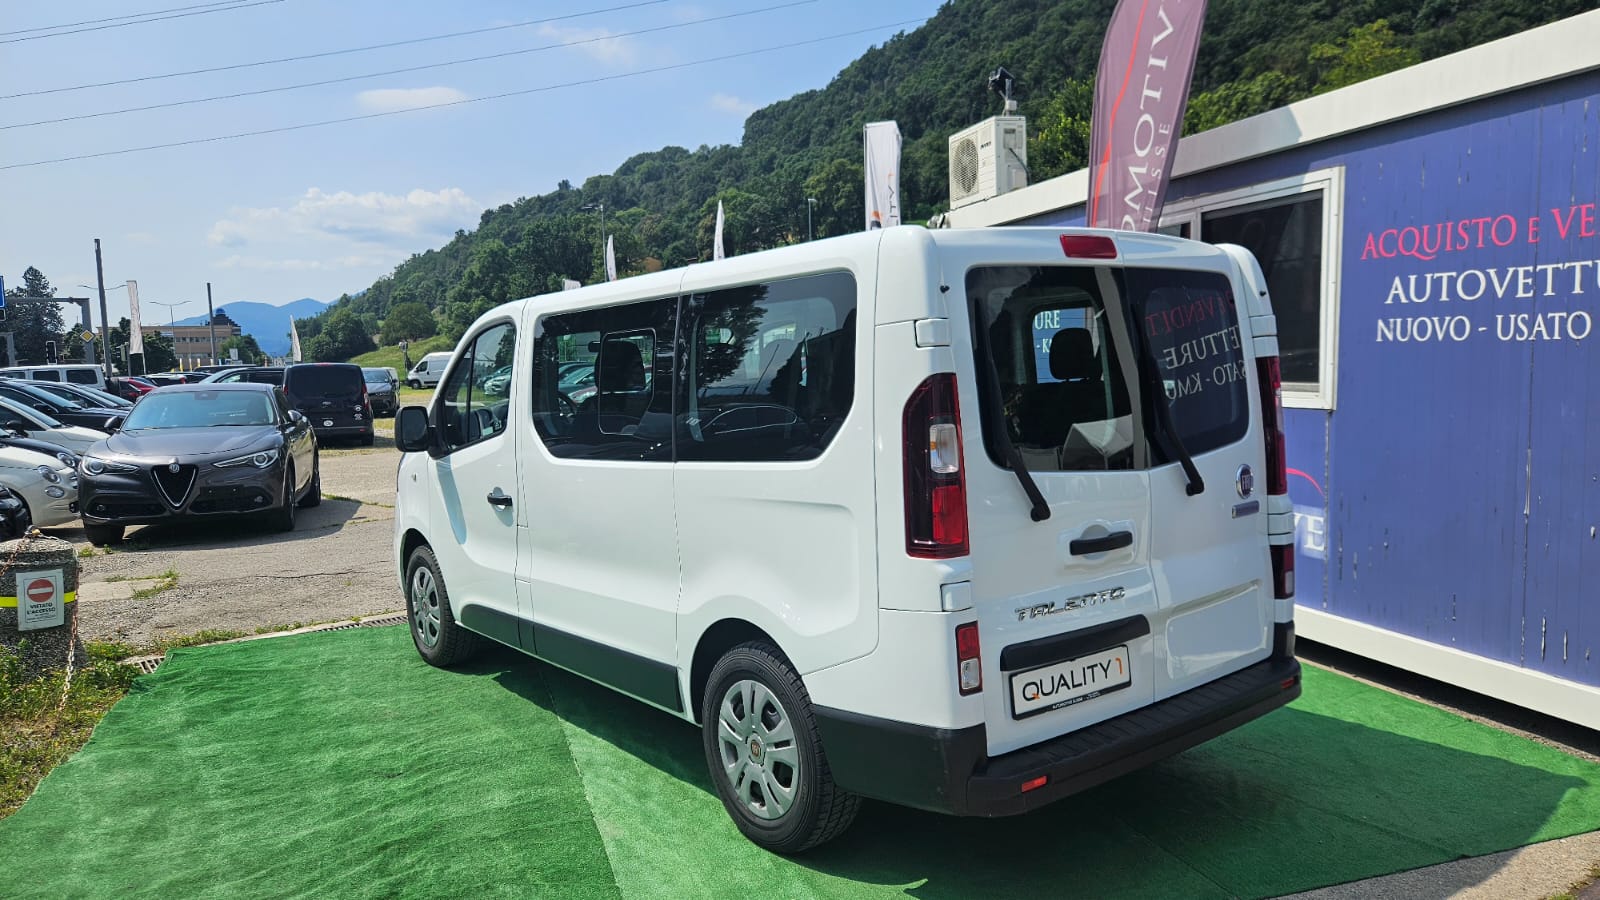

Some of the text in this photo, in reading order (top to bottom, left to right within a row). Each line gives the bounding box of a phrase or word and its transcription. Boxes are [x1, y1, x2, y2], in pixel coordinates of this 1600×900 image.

[1121, 0, 1180, 231] MOTIV
[1360, 214, 1517, 260] ACQUISTO
[1527, 217, 1540, 243] E
[1384, 260, 1600, 304] AUTOVETT
[1376, 315, 1471, 342] NUOVO
[1495, 311, 1592, 341] USATO
[1015, 586, 1126, 621] TALENTO
[1022, 659, 1111, 702] QUALITY
